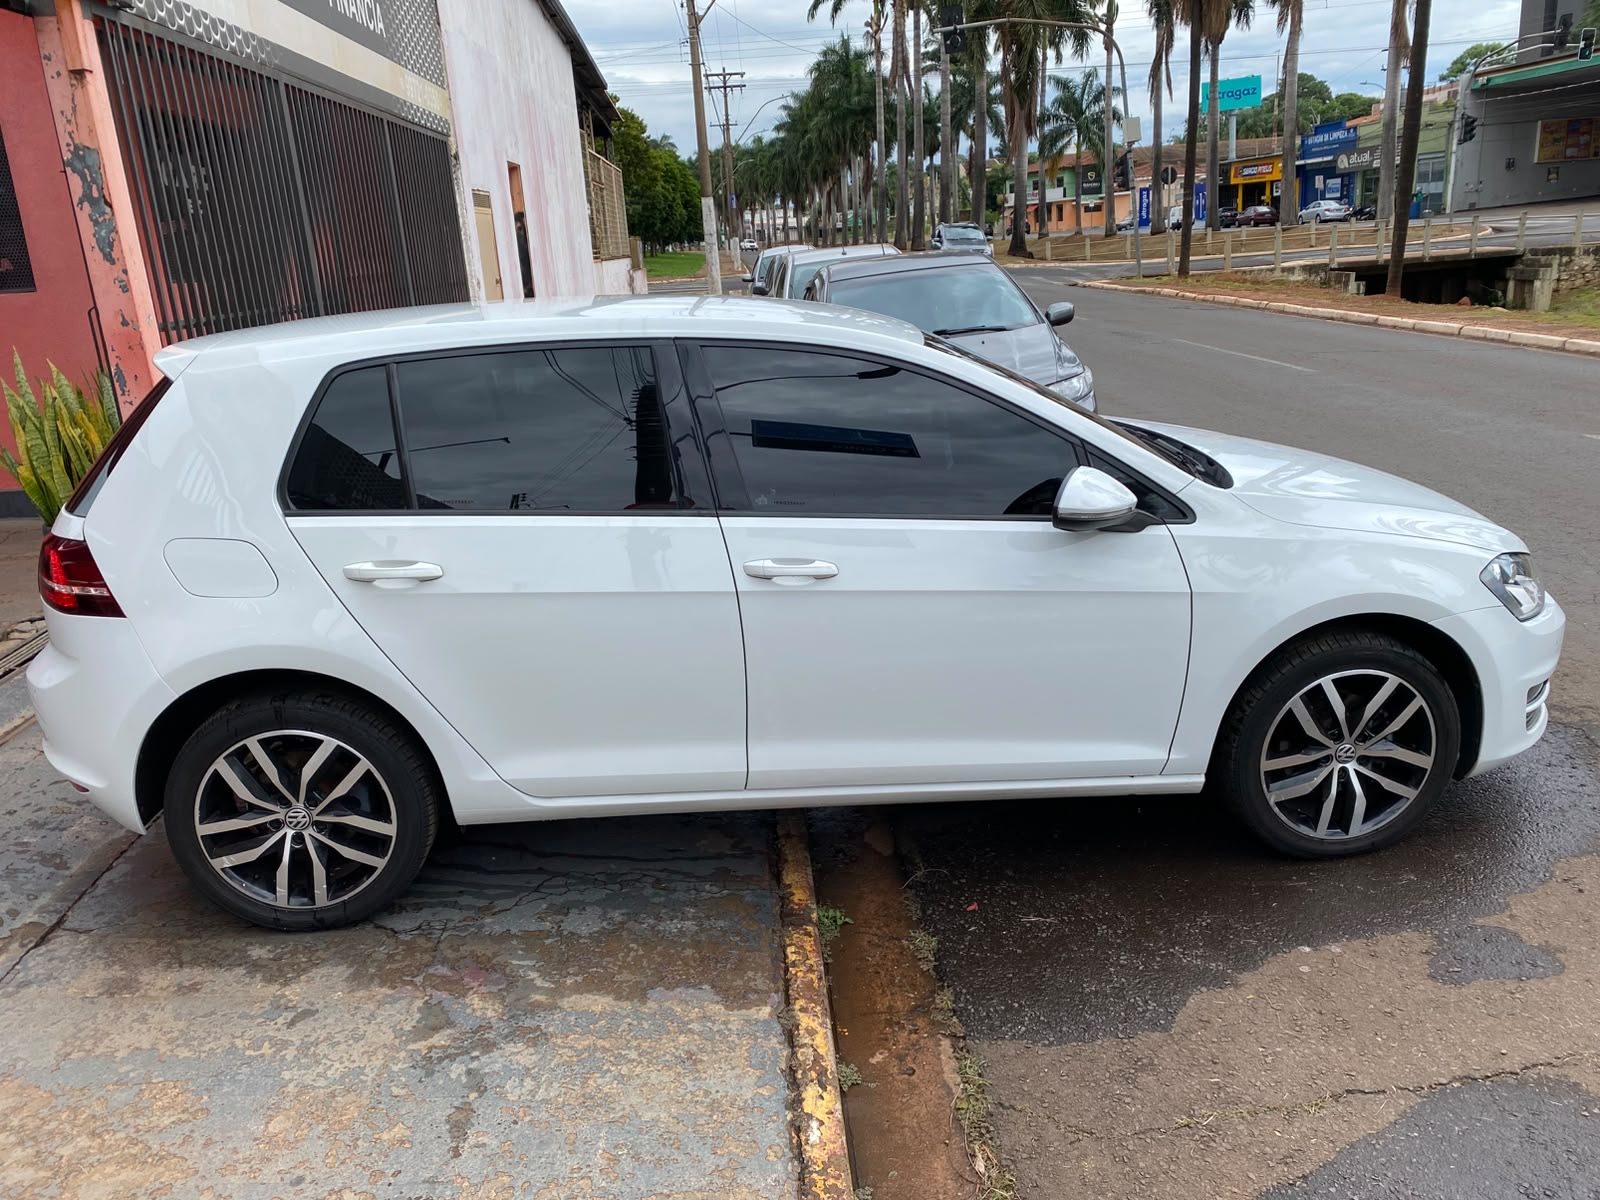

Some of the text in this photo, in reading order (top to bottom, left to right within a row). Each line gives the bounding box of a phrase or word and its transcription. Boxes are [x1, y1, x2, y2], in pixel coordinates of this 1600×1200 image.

[328, 0, 386, 38] ANCIA
[1206, 87, 1257, 100] ragaz
[1350, 150, 1370, 164] atual
